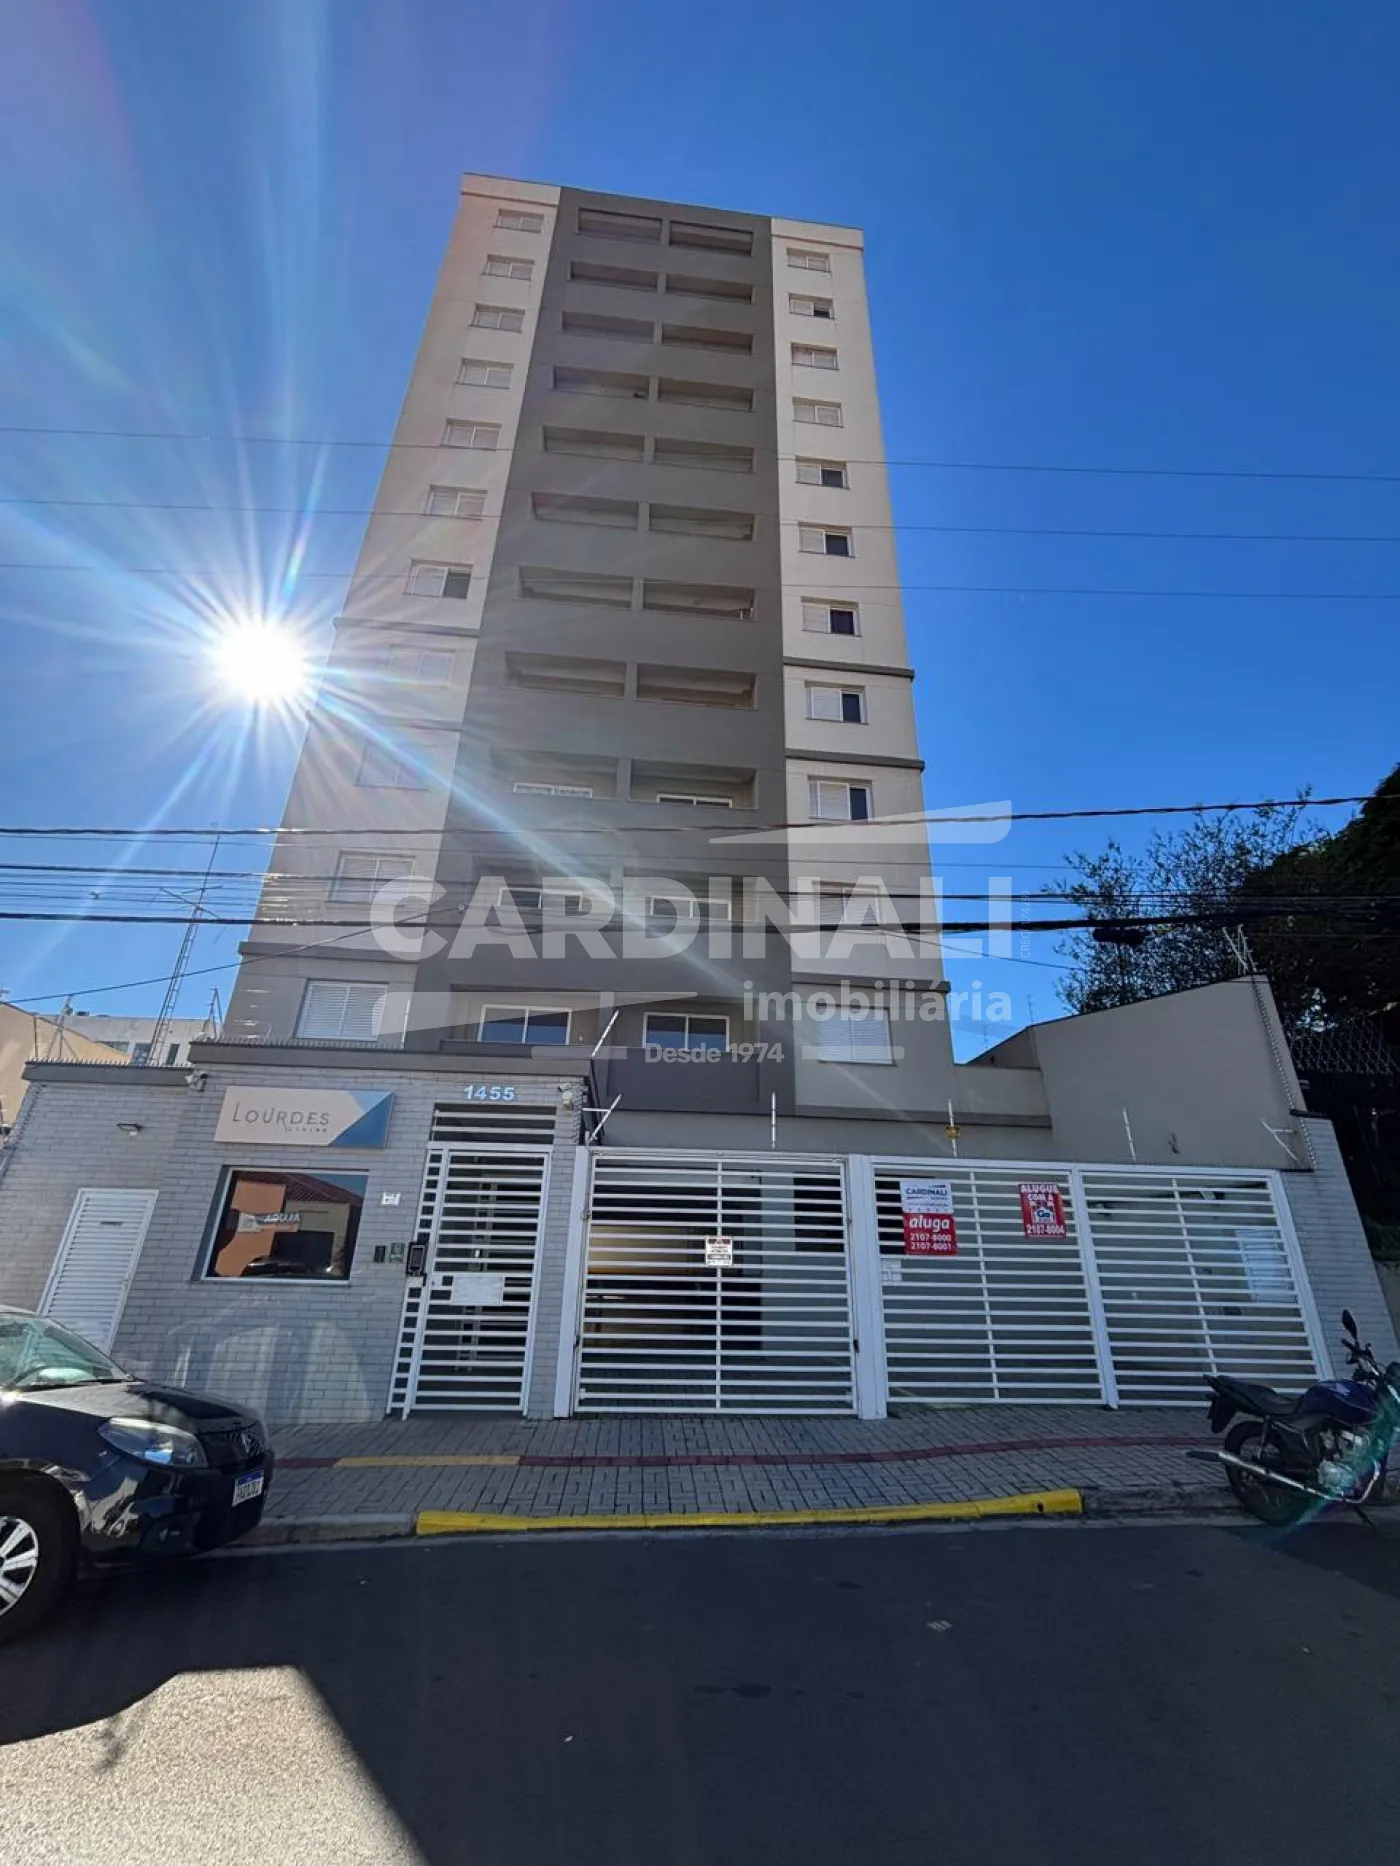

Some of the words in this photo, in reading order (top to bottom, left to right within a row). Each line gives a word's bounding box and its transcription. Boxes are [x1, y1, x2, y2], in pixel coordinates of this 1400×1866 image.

[464, 1085, 515, 1101] 1455
[905, 1187, 948, 1196] CARDINALI
[909, 1214, 950, 1233] aluga
